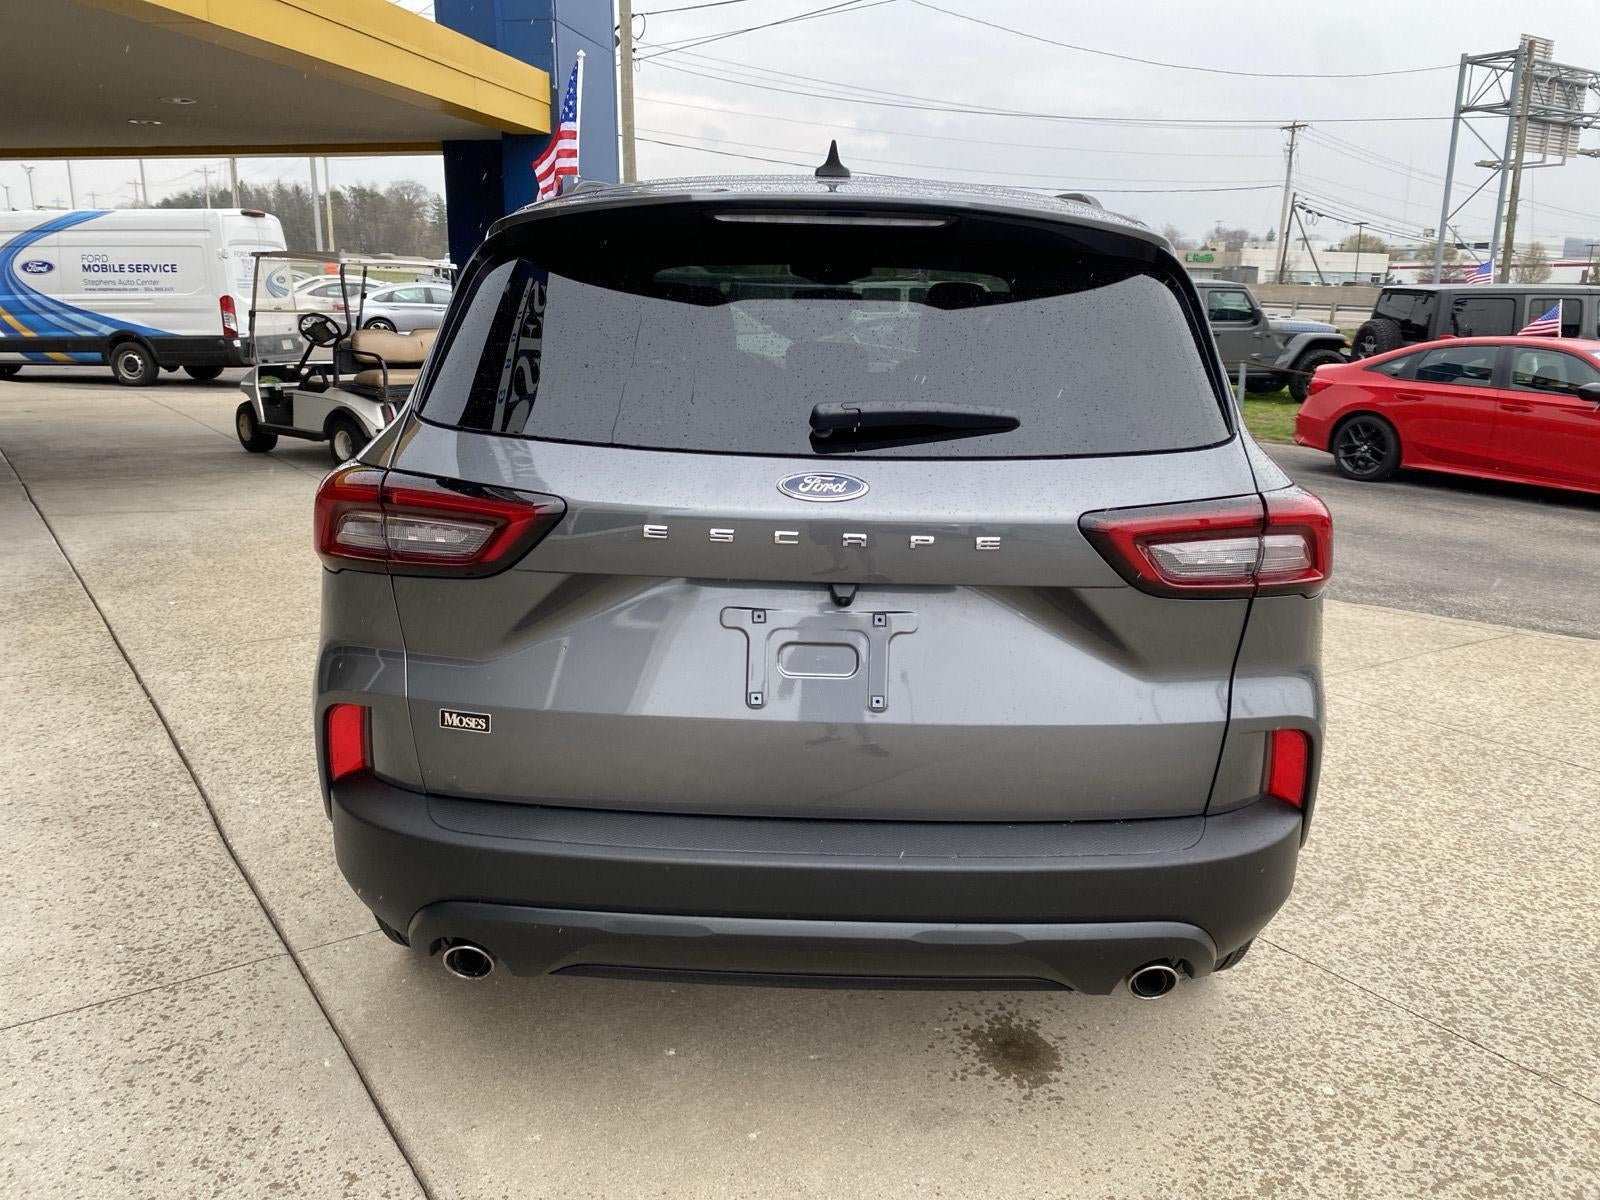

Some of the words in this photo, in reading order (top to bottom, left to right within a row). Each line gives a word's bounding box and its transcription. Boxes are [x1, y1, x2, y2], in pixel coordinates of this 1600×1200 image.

[81, 254, 108, 263] FORD
[26, 261, 48, 272] Ford
[81, 263, 126, 273] MOBILE
[127, 263, 178, 273] SERVICE
[83, 279, 116, 287] Stephens
[136, 278, 160, 286] Center
[643, 524, 1003, 551] ESCAPE
[444, 712, 486, 730] MOSES
